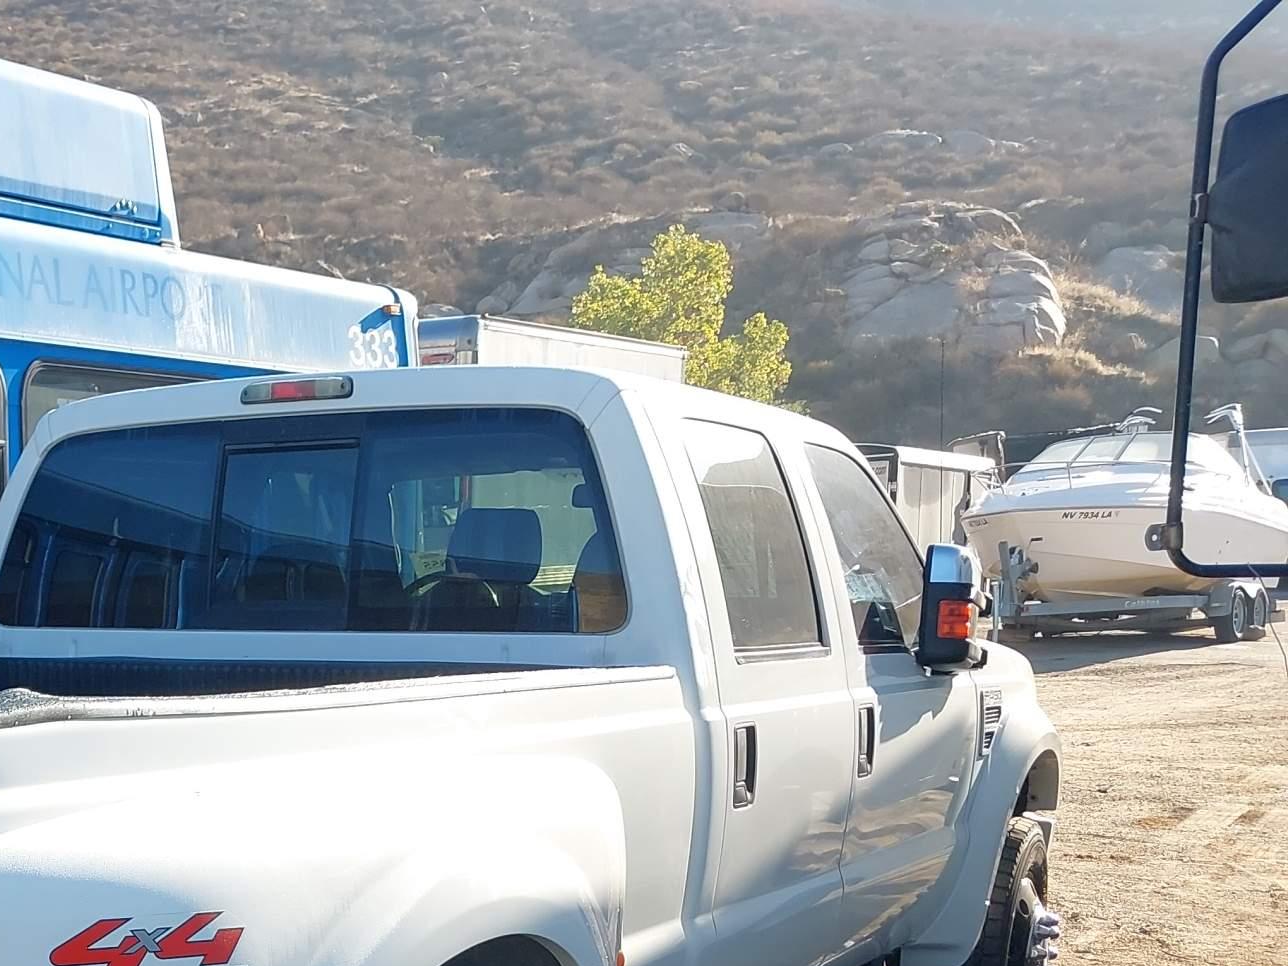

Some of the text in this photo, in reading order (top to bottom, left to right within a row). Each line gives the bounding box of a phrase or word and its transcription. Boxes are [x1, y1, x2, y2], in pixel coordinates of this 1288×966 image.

[84, 262, 223, 325] AIRPOT
[348, 324, 397, 368] 333
[1062, 511, 1076, 519] NV
